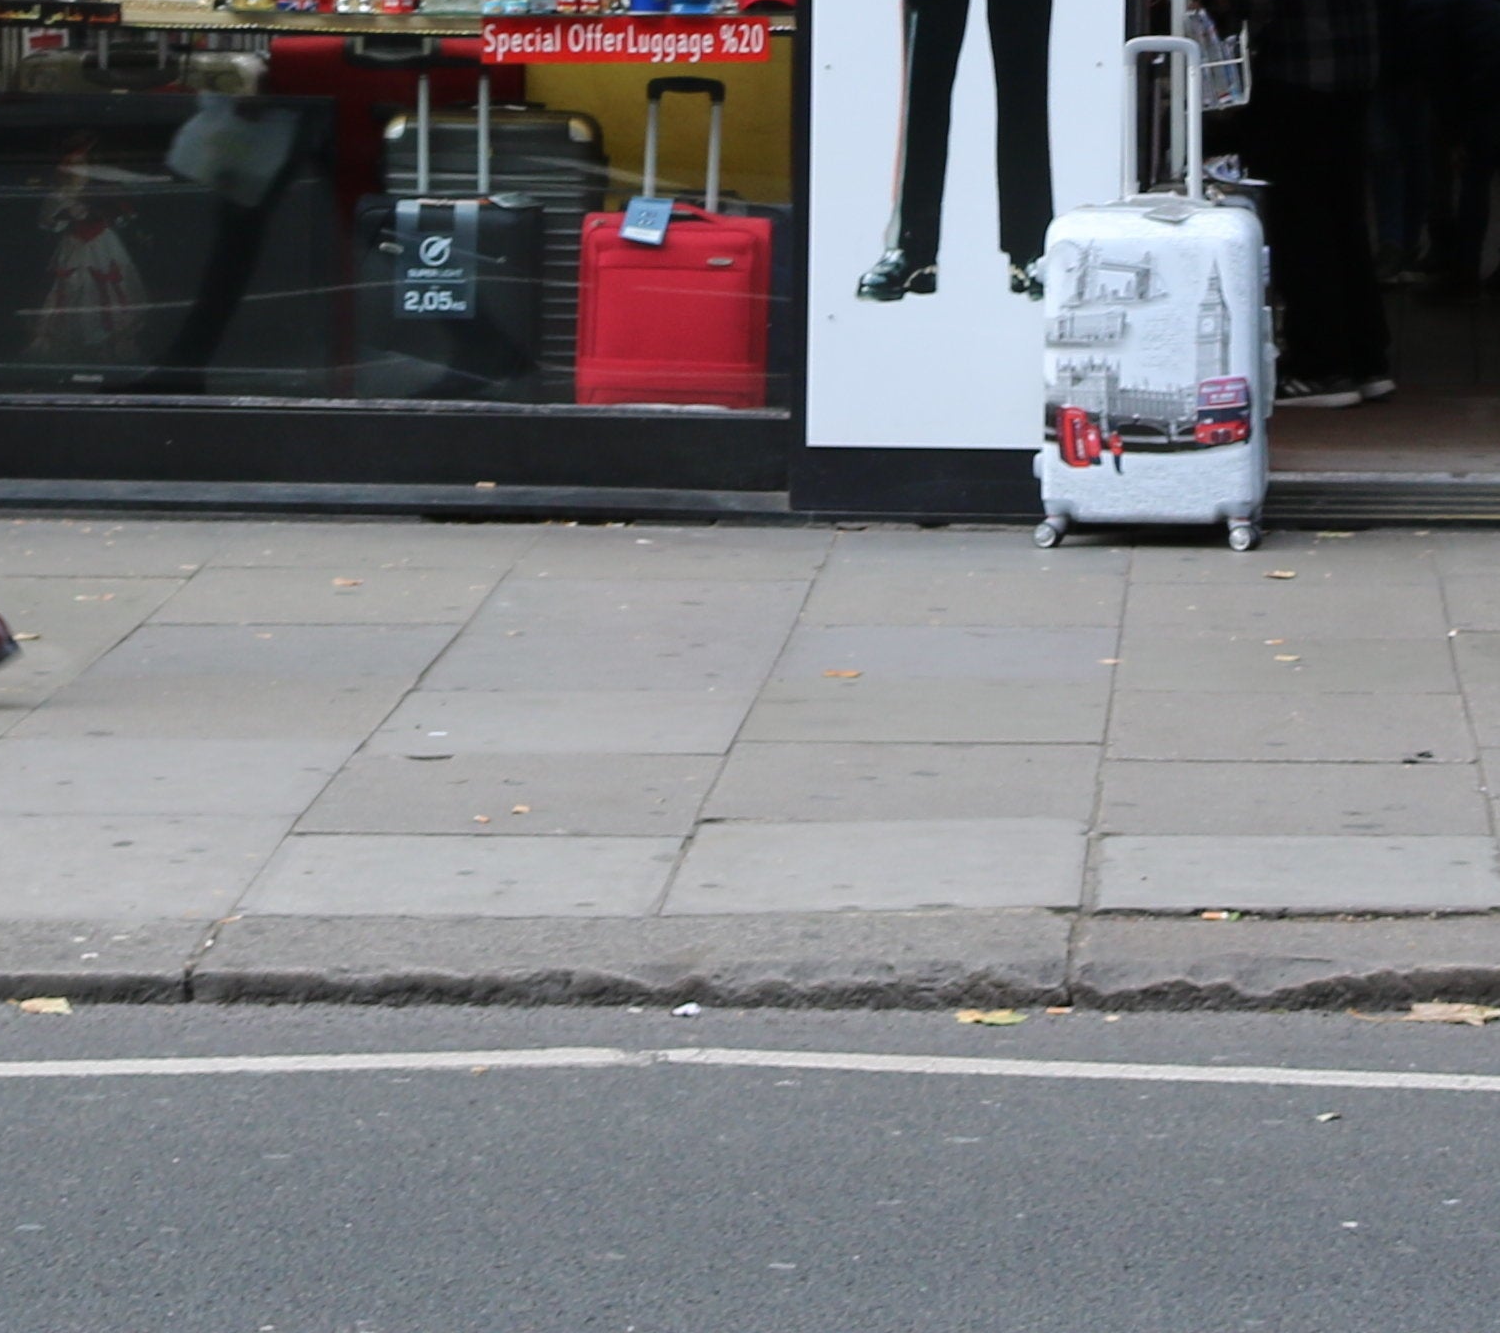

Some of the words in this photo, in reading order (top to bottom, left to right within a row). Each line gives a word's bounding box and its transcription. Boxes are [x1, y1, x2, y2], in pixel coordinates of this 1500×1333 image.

[483, 22, 562, 63] Special
[567, 22, 626, 54] Offer
[627, 23, 715, 64] Luggage
[719, 23, 765, 55] %20
